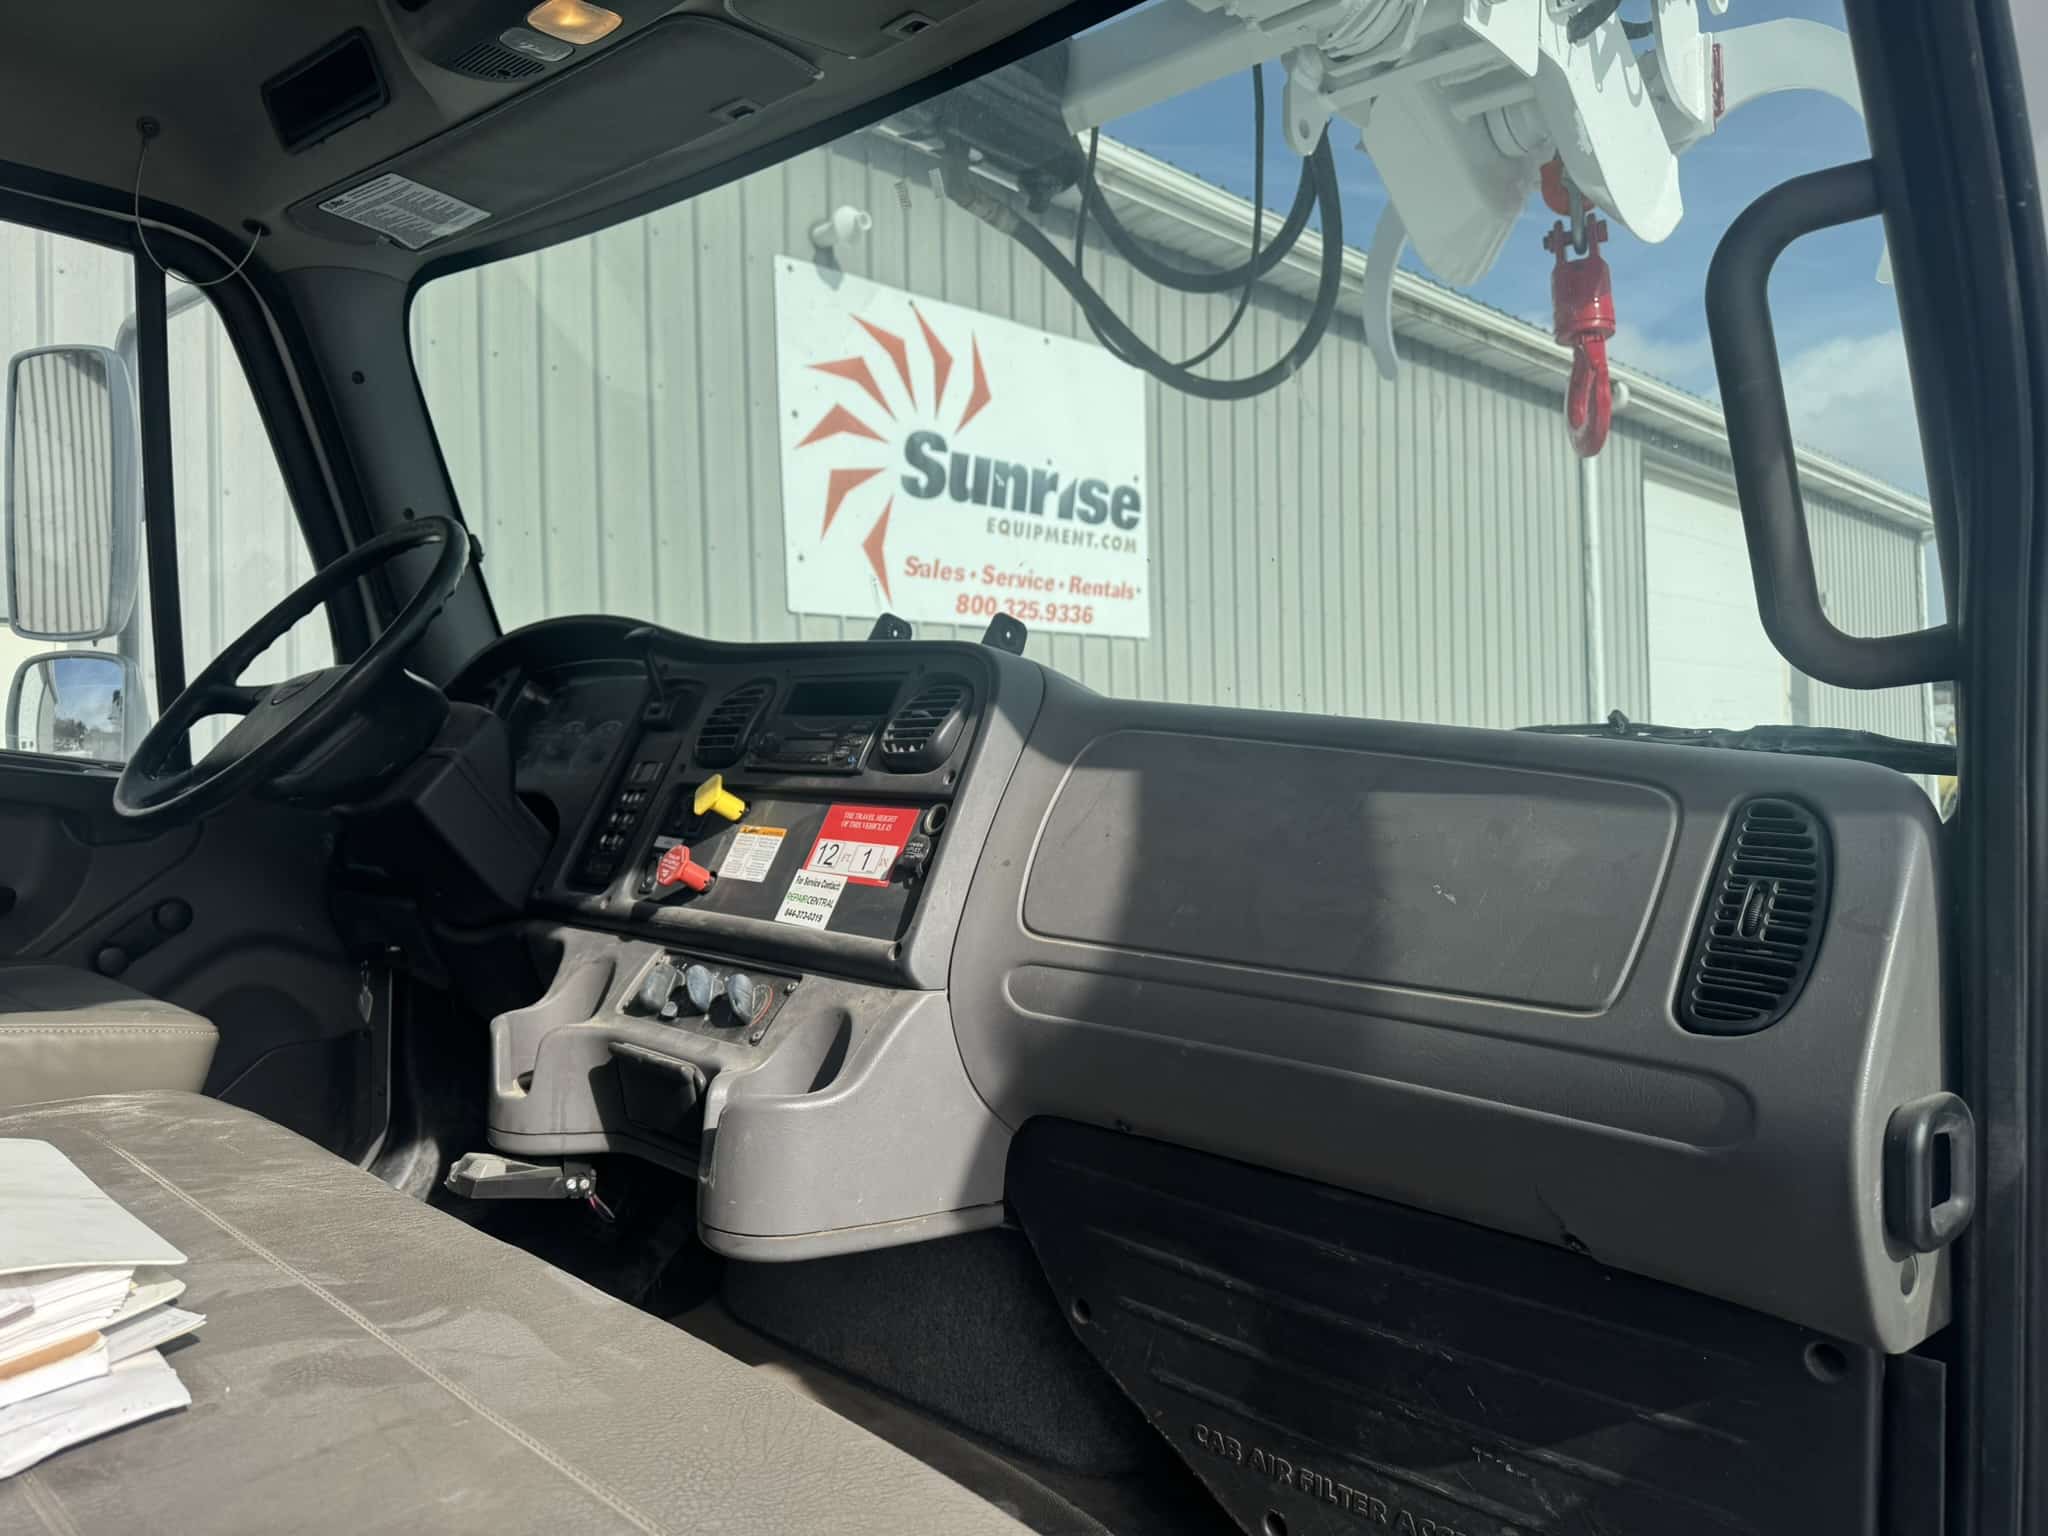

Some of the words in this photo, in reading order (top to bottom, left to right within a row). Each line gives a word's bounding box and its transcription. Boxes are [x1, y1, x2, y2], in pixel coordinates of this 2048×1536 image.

[901, 429, 1141, 530] Sunrise
[986, 517, 1136, 553] EQUIPMENT.COM
[904, 555, 966, 583] Sales
[982, 563, 1055, 592] Service
[1069, 576, 1134, 601] Rentals
[955, 593, 1094, 624] 800325.9336
[817, 841, 840, 866] 12
[862, 847, 873, 871] 1
[804, 876, 821, 888] Service
[1193, 1423, 1242, 1464] CAB
[1249, 1447, 1293, 1485] AIR
[1299, 1467, 1387, 1525] FILTER
